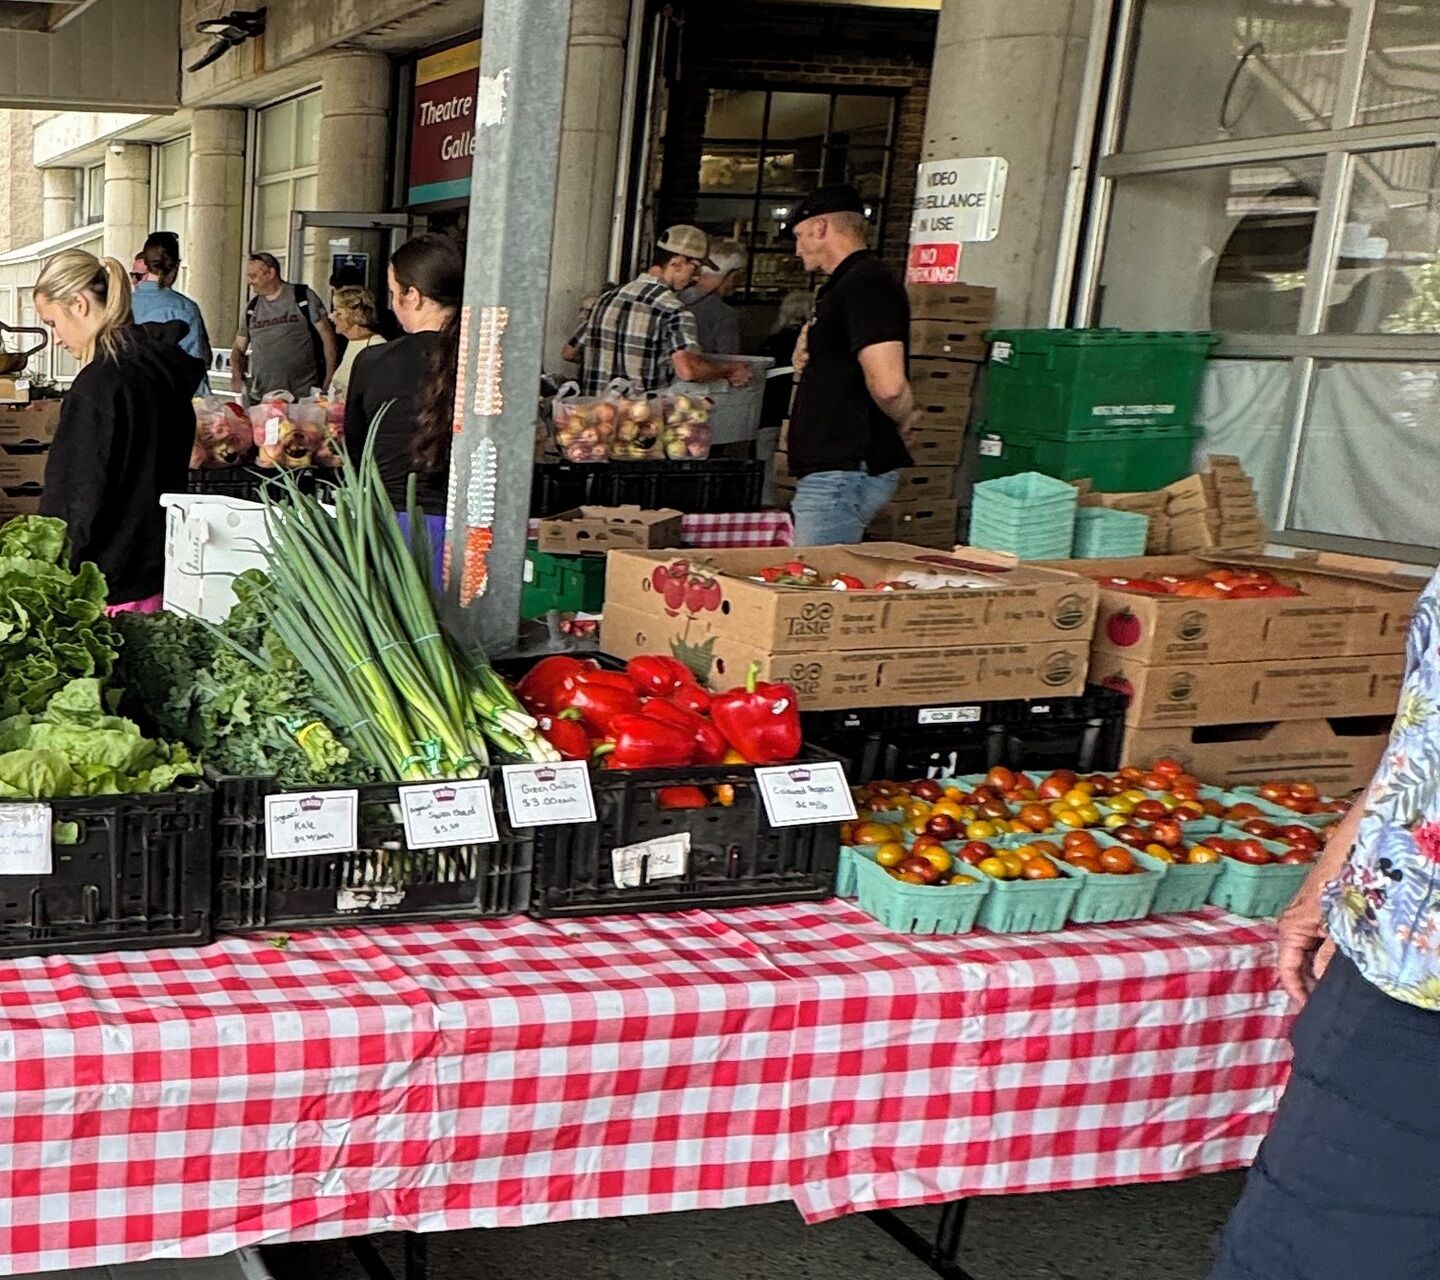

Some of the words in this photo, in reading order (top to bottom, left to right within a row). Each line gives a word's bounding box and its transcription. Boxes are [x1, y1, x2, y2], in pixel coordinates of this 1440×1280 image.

[419, 96, 473, 127] Theatre
[441, 131, 477, 161] Galle
[931, 217, 955, 231] USE
[921, 248, 937, 264] NO
[785, 617, 831, 636] Taste
[521, 783, 549, 795] Green
[453, 806, 476, 816] Chard
[294, 821, 316, 830] Kale
